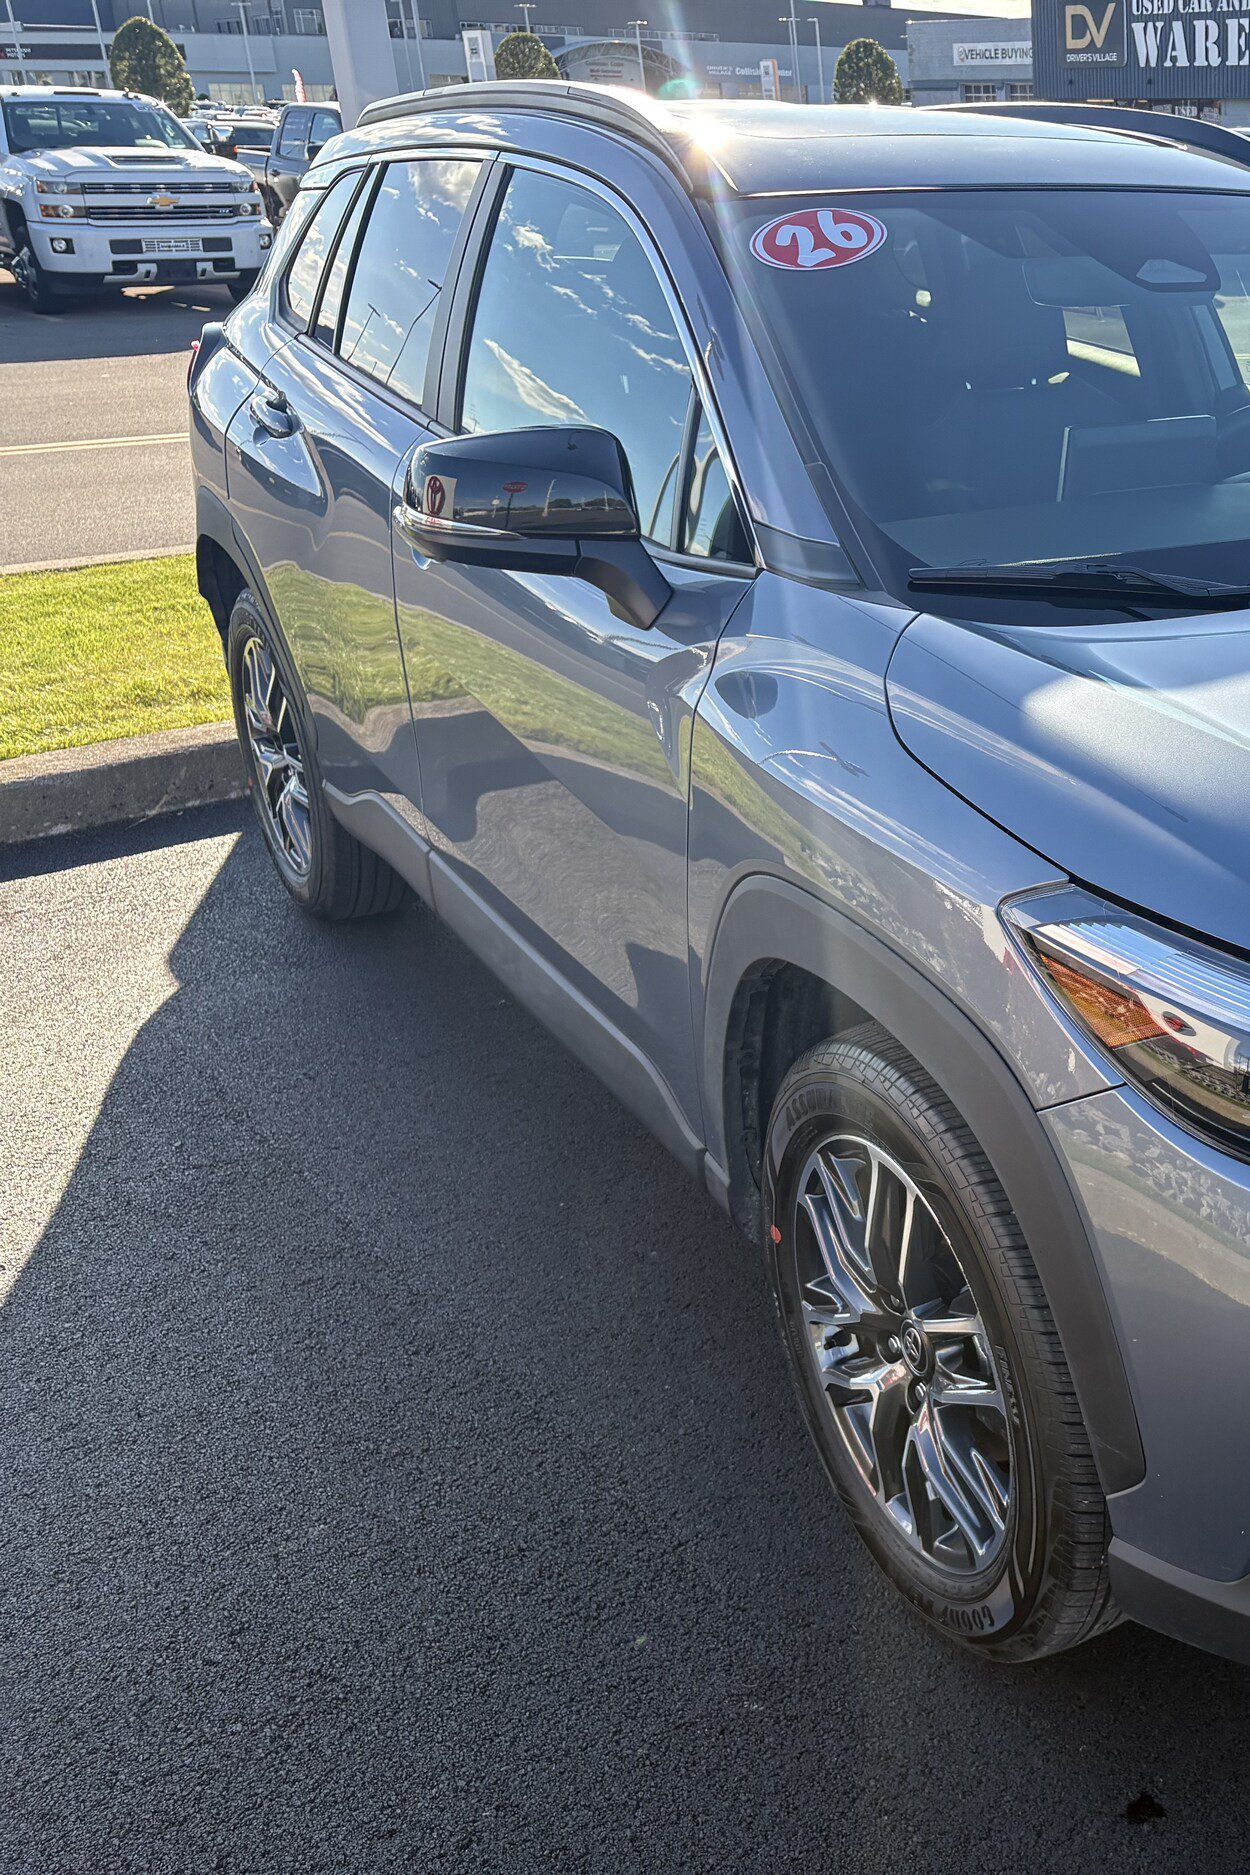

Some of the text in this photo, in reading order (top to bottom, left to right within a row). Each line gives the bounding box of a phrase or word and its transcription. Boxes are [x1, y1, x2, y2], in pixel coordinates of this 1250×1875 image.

[1065, 3, 1116, 49] DV
[964, 48, 1000, 60] VEHICLE
[1092, 52, 1118, 62] VILLAGE
[775, 210, 868, 267] 26
